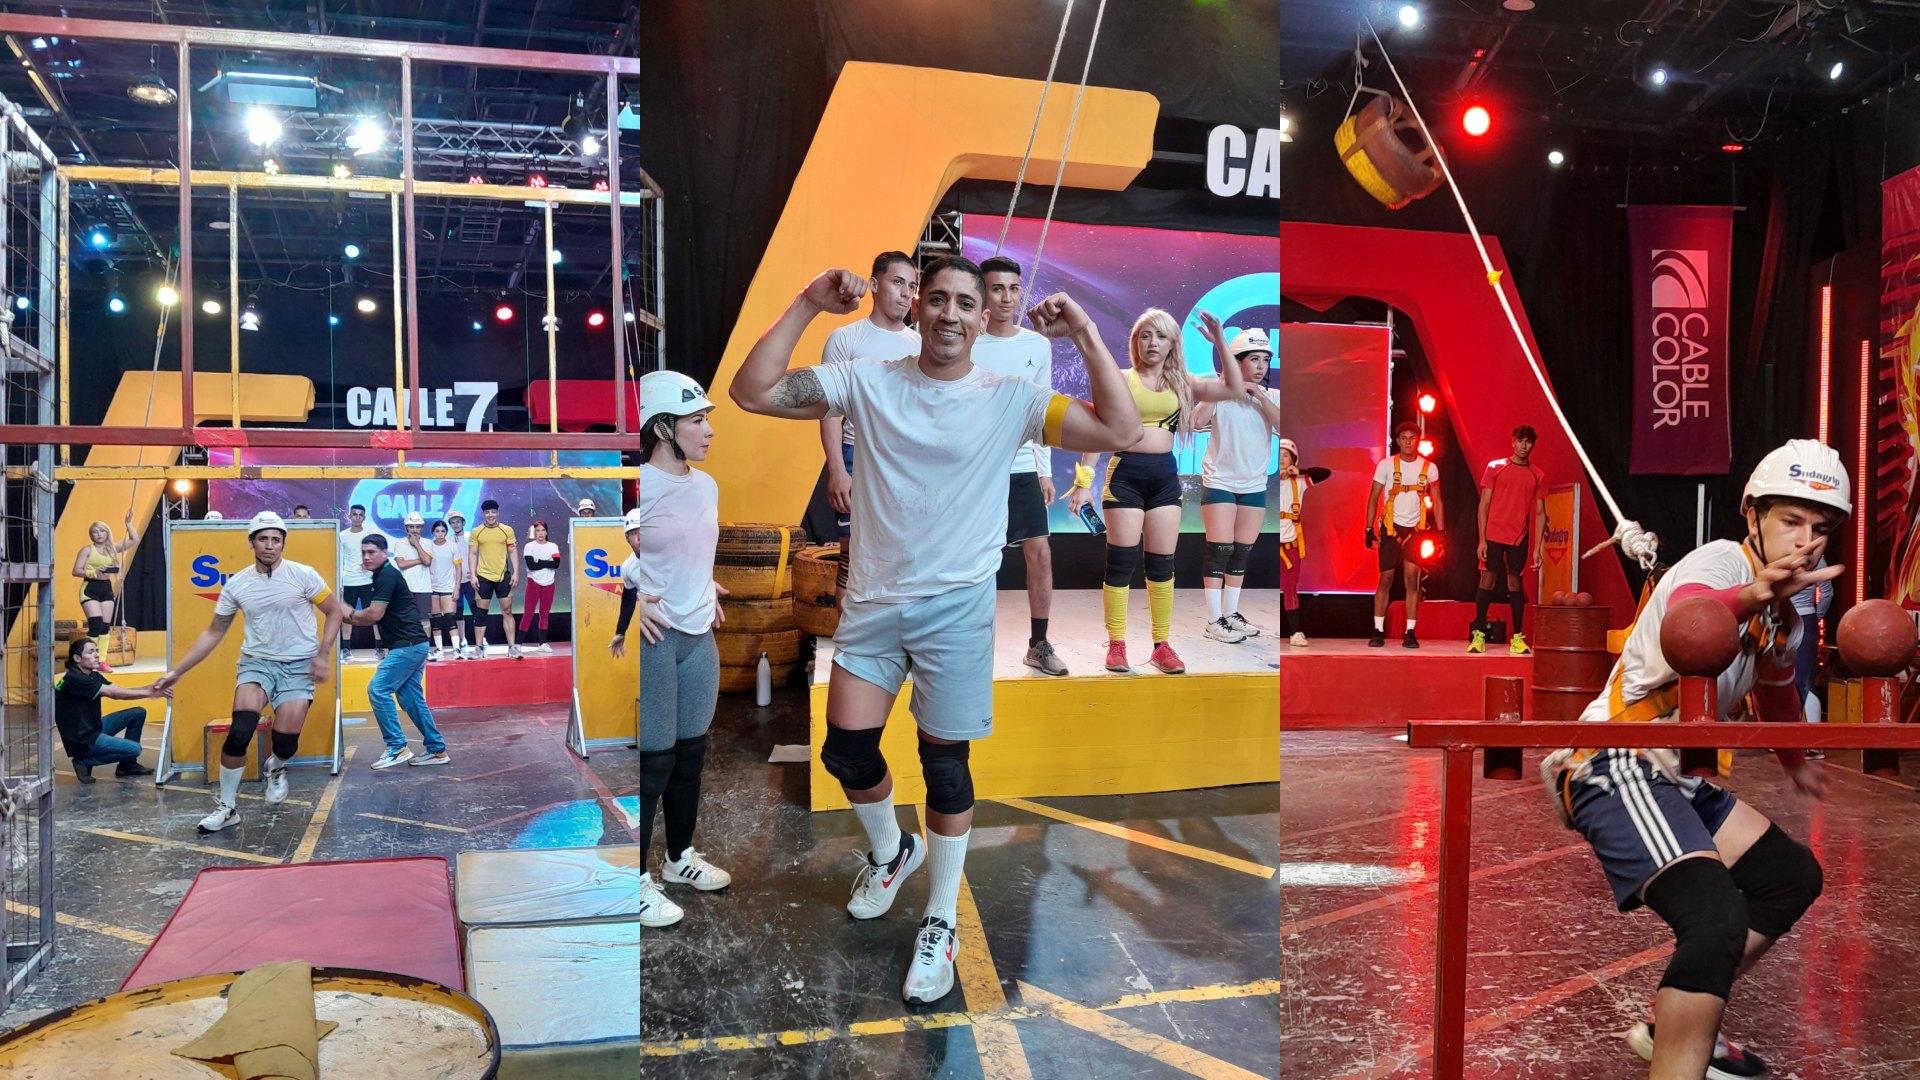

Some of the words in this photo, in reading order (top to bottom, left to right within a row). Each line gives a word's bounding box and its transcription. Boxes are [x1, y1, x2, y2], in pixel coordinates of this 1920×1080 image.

[1206, 124, 1280, 198] CA
[1652, 312, 1681, 430] COLOR
[1682, 312, 1709, 418] CABLE
[453, 381, 498, 433] 7
[376, 494, 445, 519] CALLE
